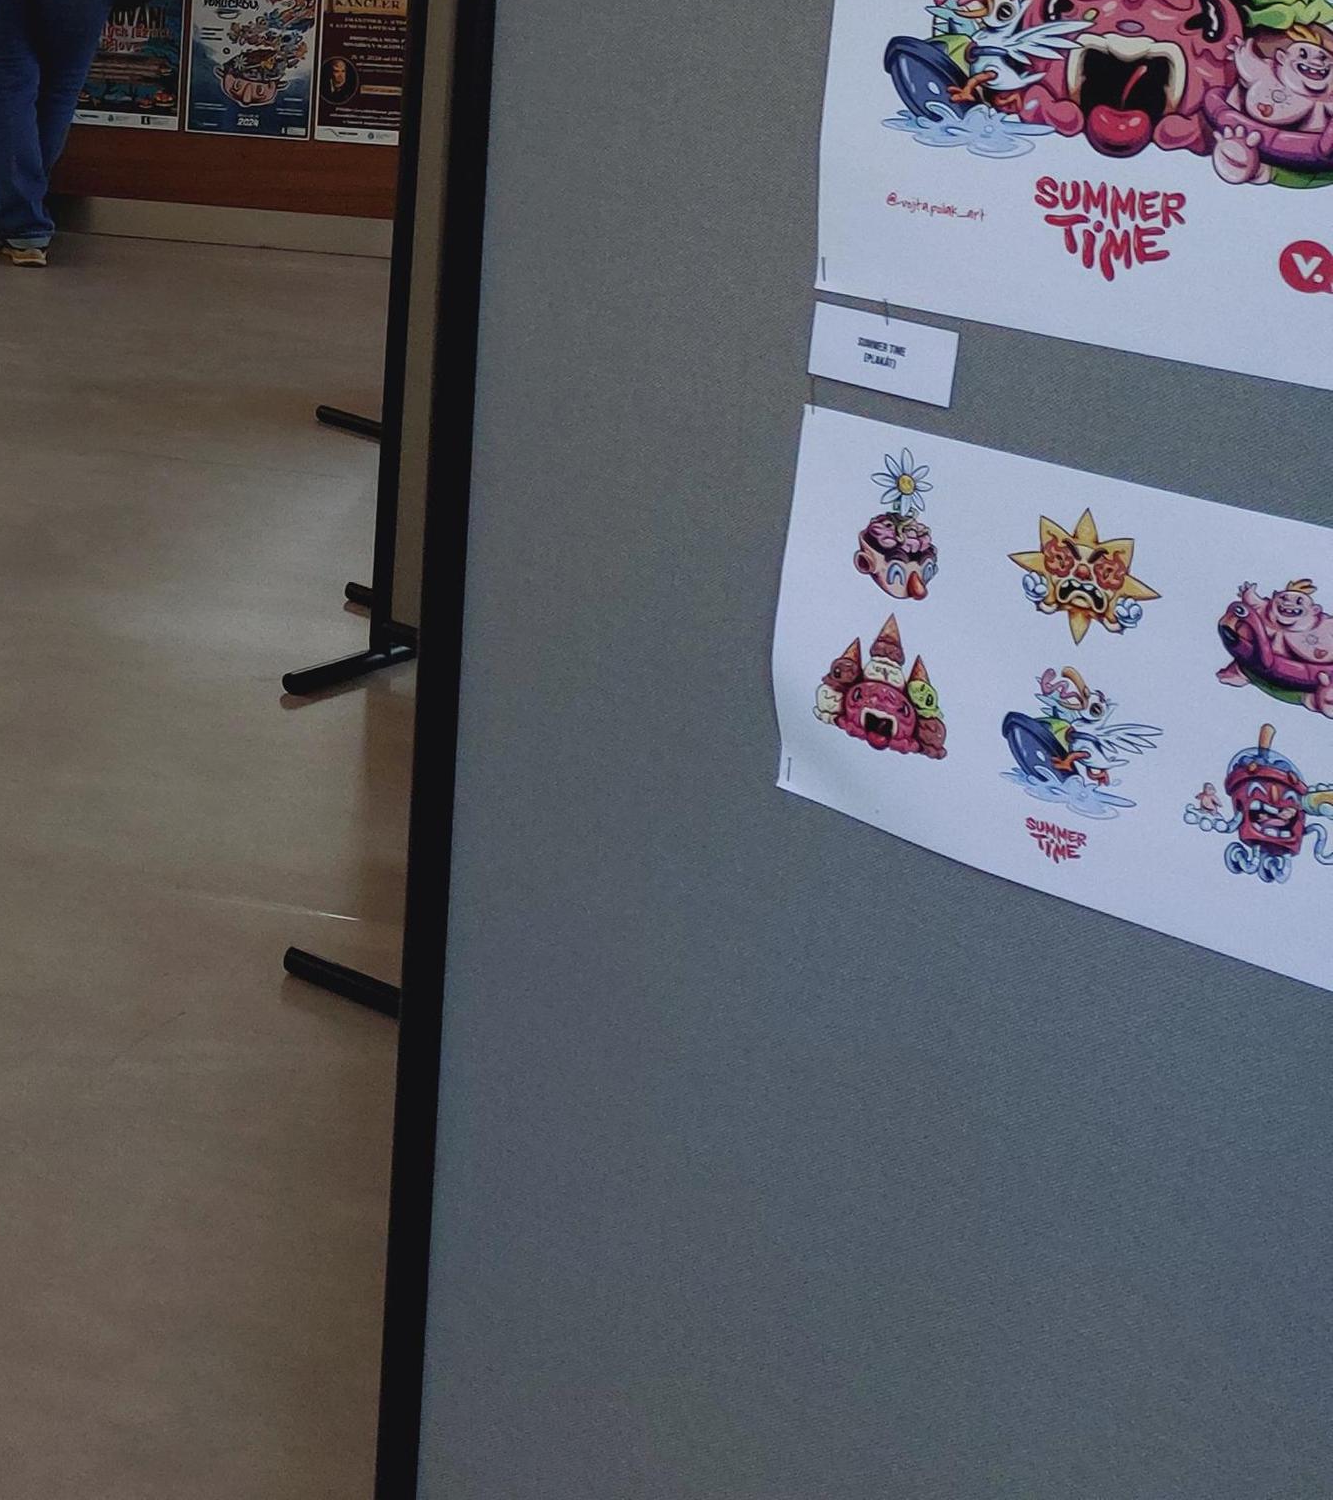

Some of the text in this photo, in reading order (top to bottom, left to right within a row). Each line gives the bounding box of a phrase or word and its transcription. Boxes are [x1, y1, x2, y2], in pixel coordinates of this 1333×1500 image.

[1034, 175, 1186, 229] SUMMER
[857, 336, 889, 353] SUMMER
[1025, 817, 1087, 848] SUMMER
